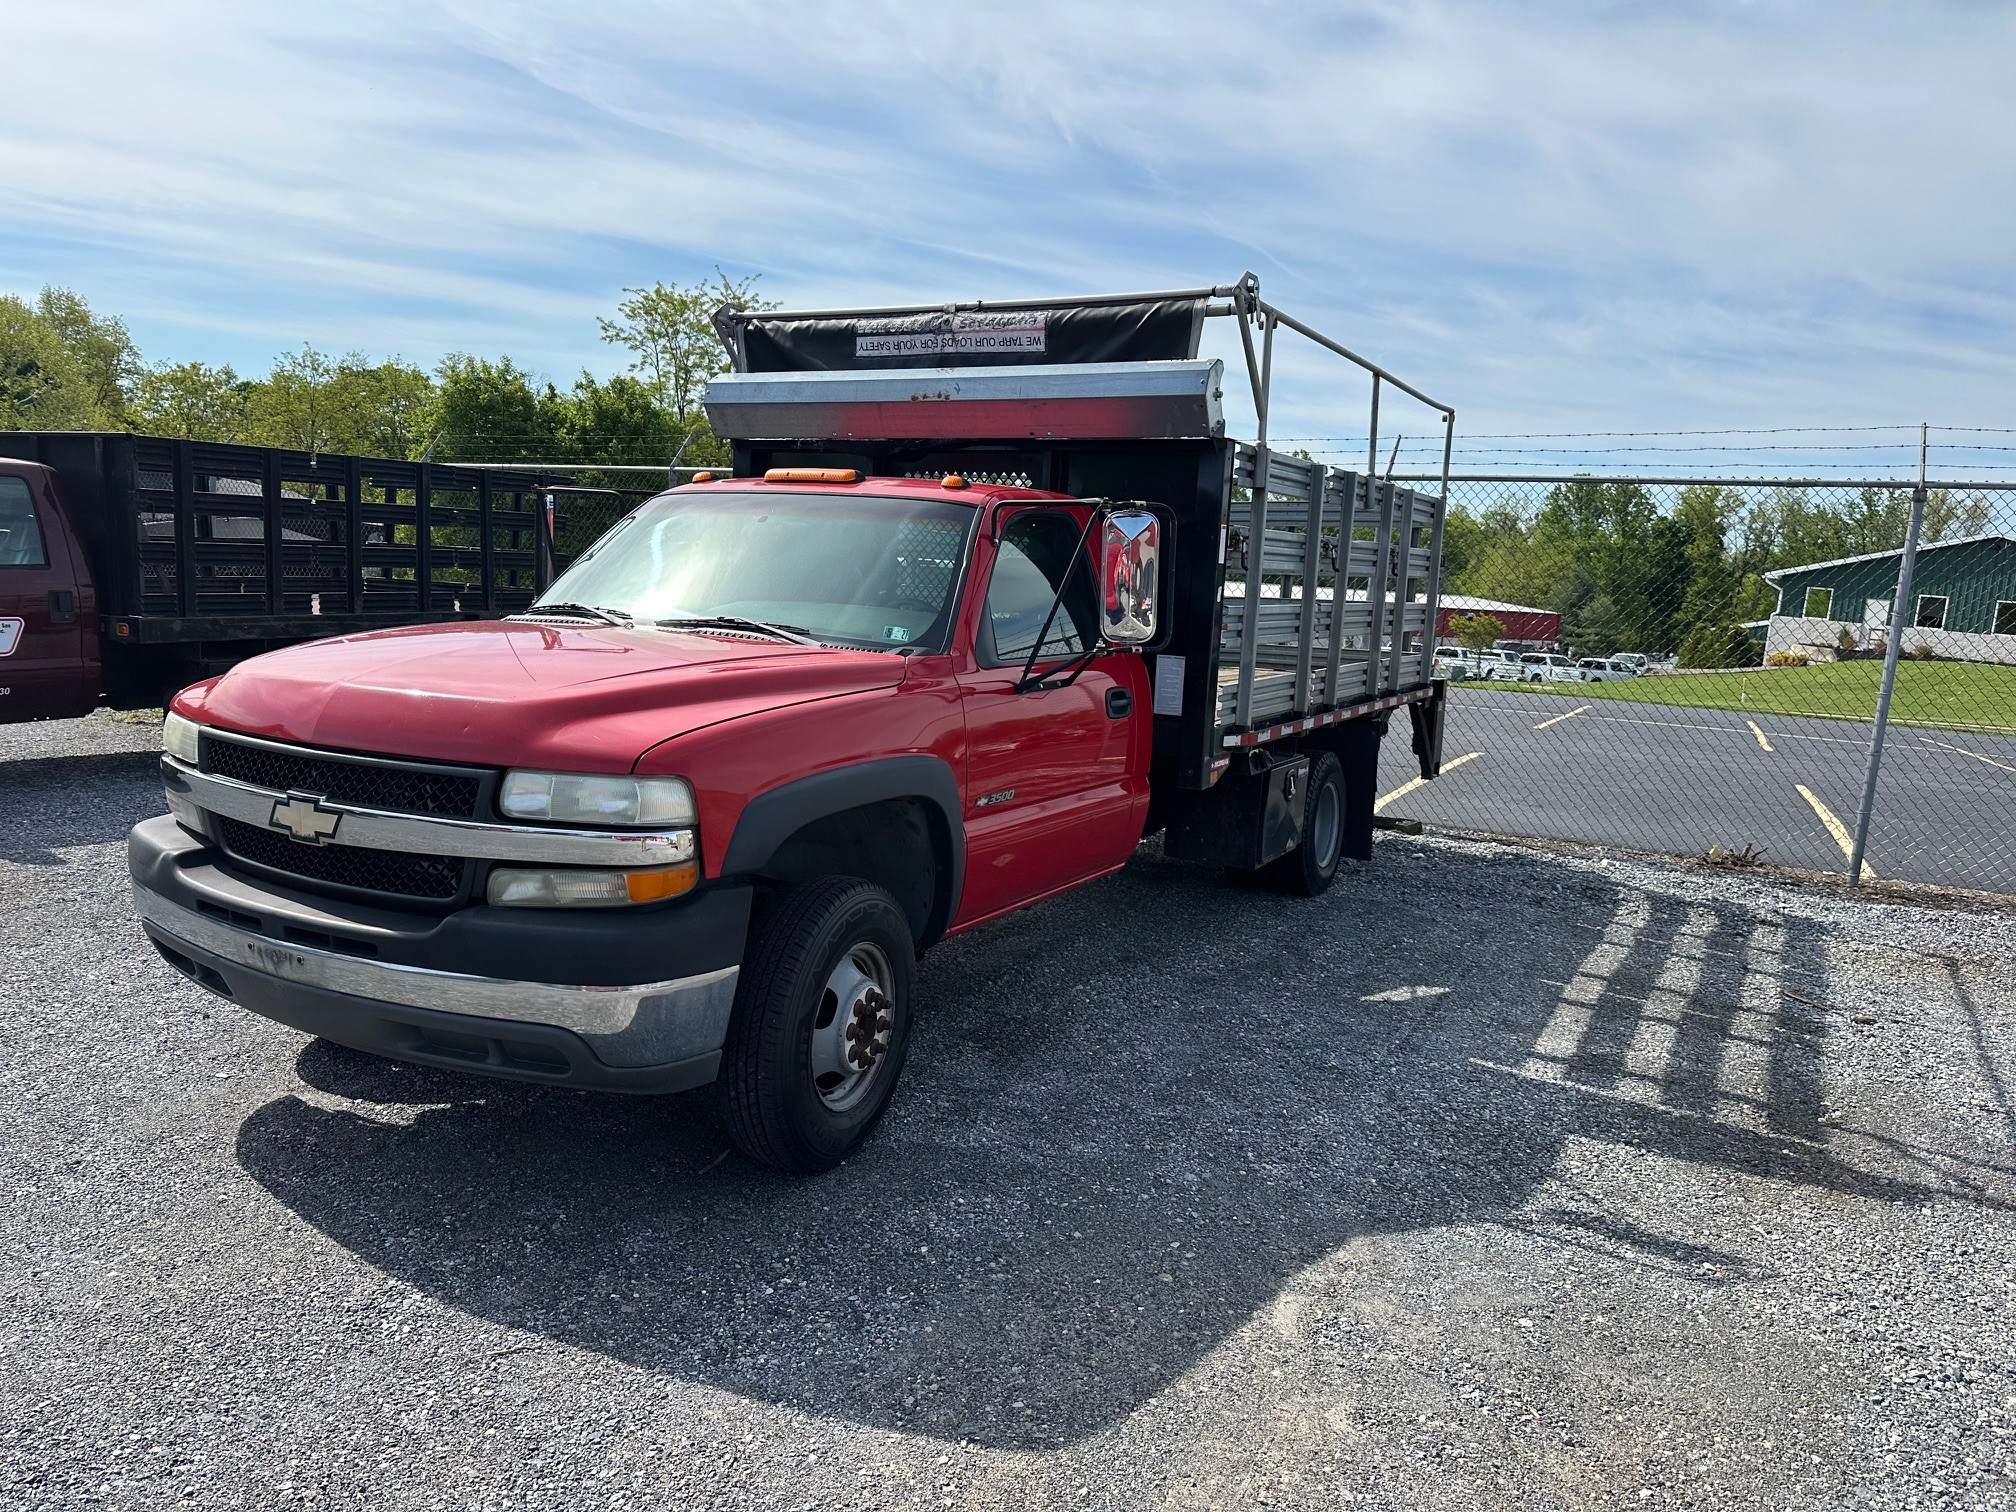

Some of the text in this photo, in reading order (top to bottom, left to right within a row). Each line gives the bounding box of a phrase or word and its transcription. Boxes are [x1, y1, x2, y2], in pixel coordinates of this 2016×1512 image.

[858, 336, 1043, 351] WE TARP OUR LOADS FOR YOUR SAFETY
[901, 629, 909, 640] 27
[988, 789, 1015, 804] 3500
